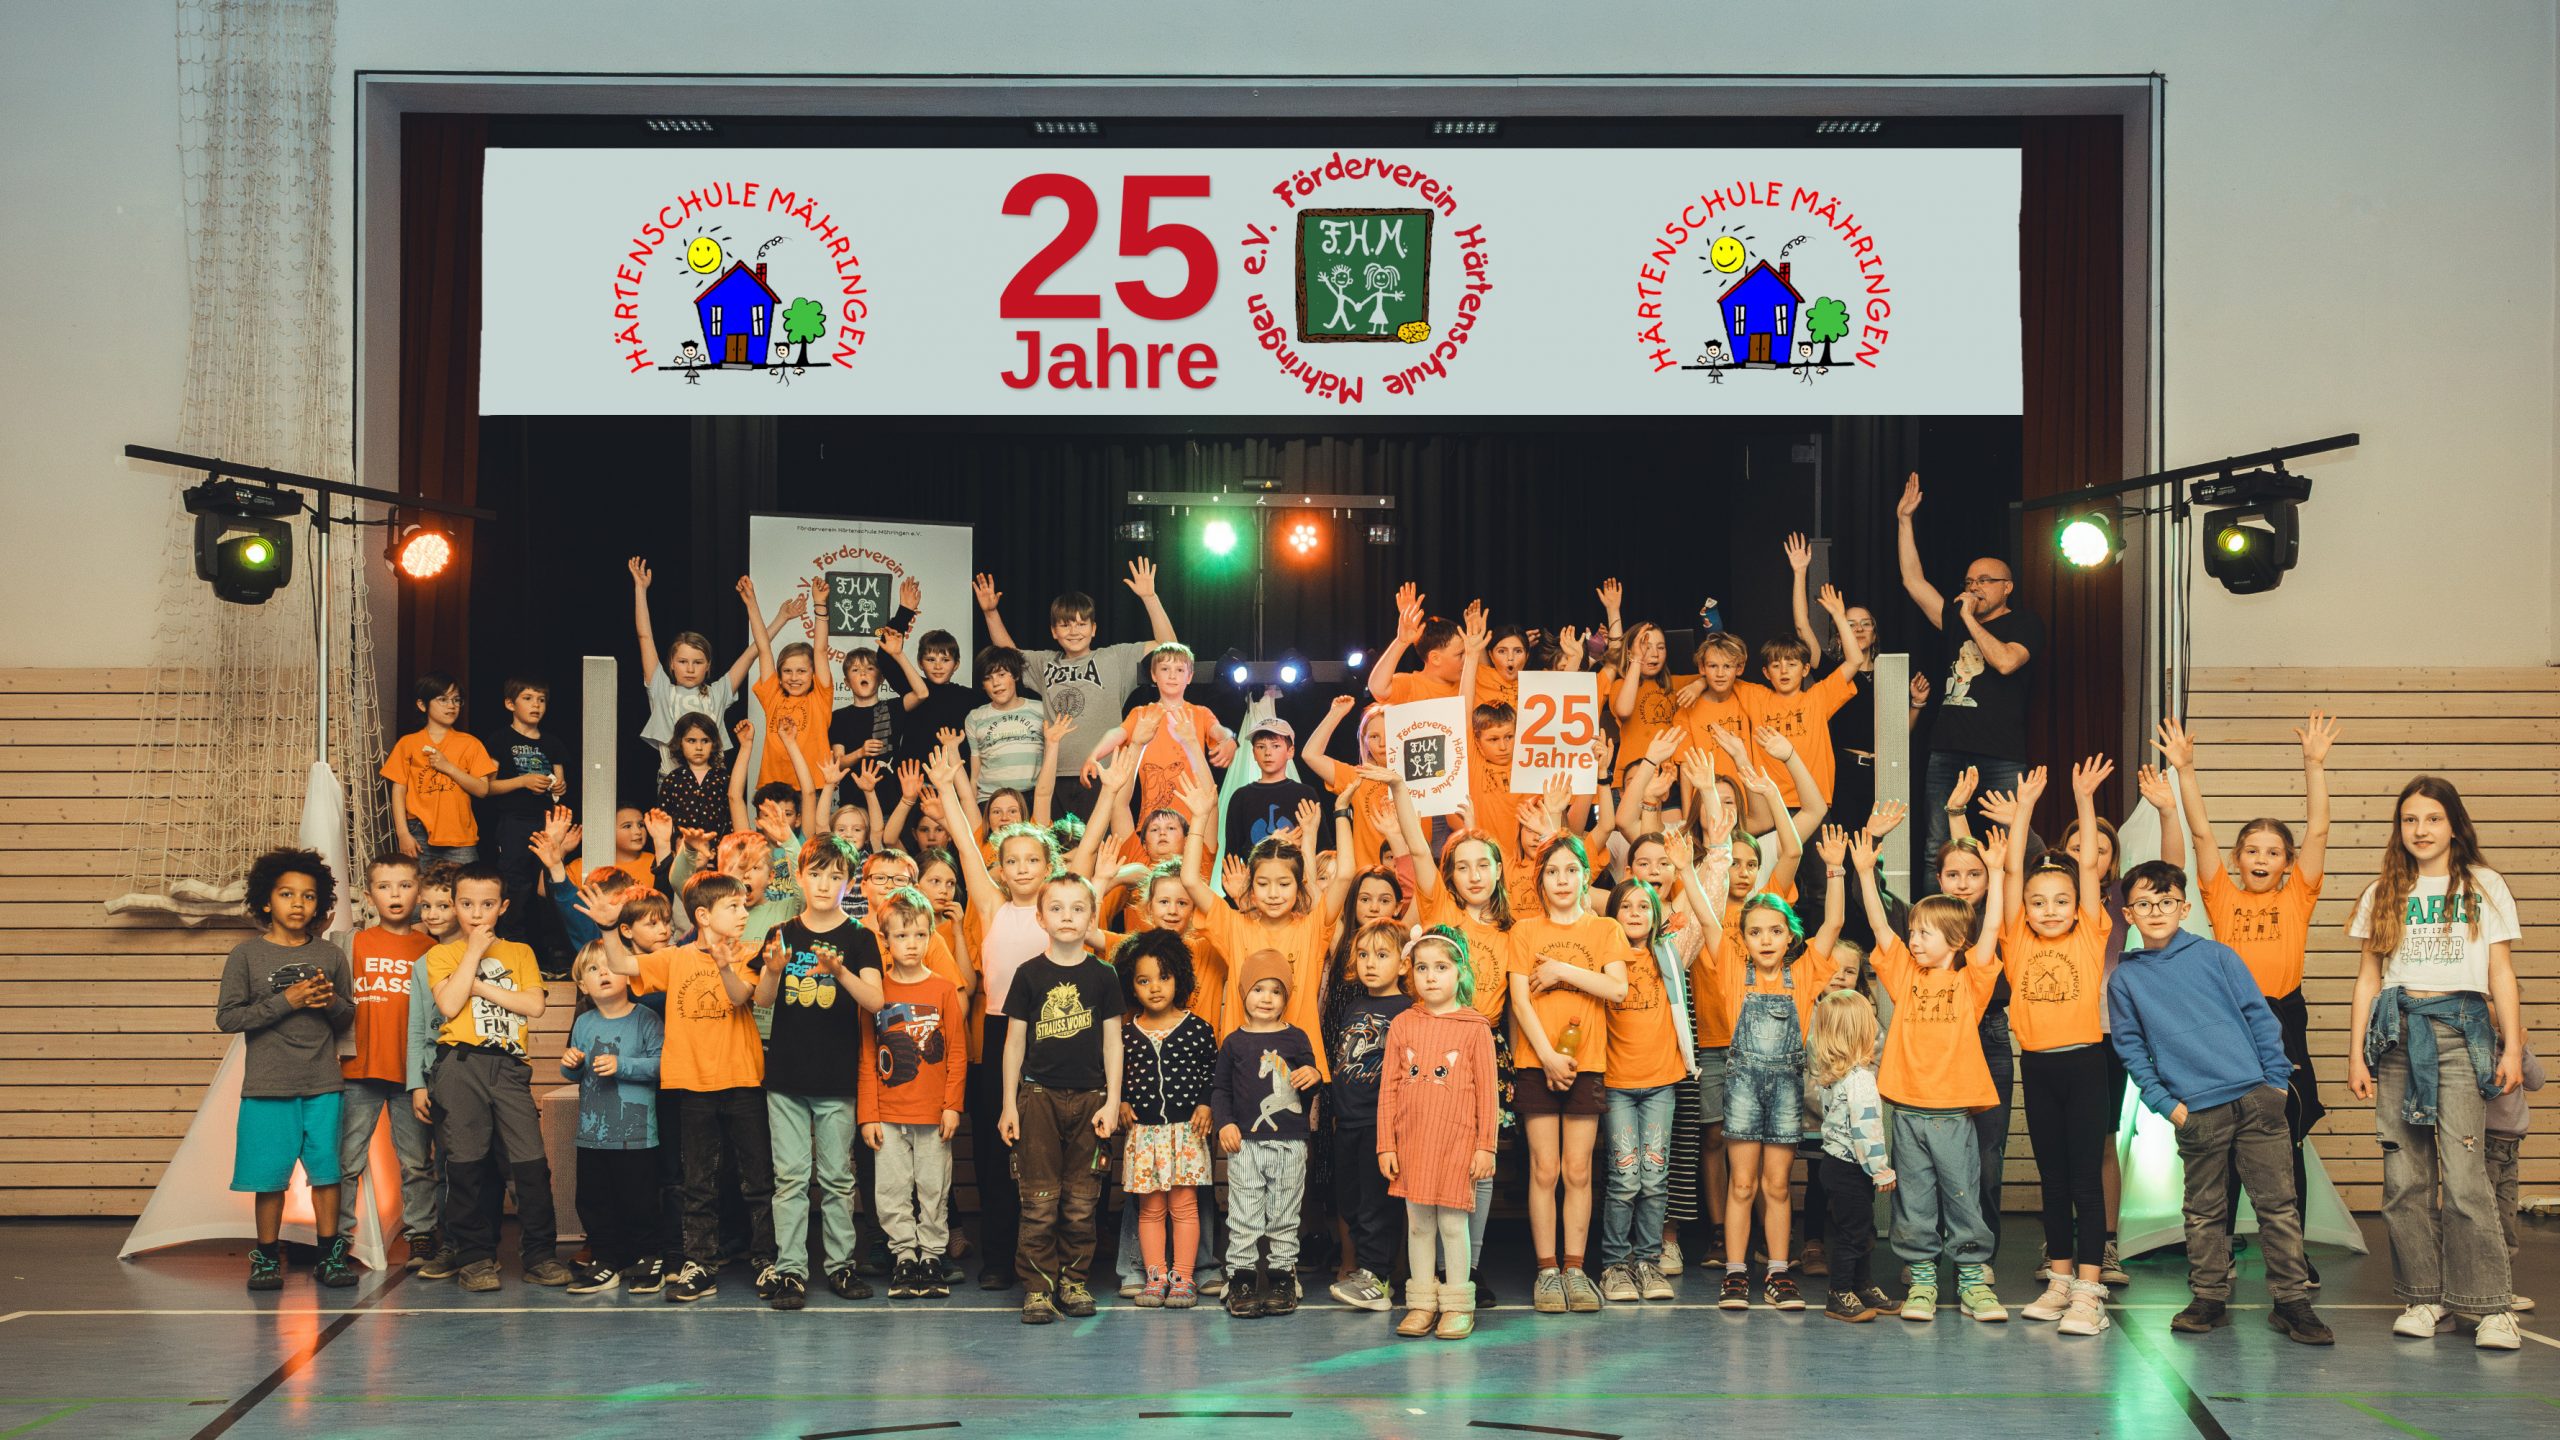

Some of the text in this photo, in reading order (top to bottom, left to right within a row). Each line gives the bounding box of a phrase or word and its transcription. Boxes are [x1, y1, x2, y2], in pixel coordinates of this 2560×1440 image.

[614, 181, 867, 373] HÄRTENSCHULE MÄHRINGEN
[999, 173, 1219, 320] 25
[1241, 152, 1494, 404] Förderverein Härtenschule Mähringen e.V.
[1637, 181, 1890, 372] HÄRTENSCHULE MÄHRINGEN
[999, 327, 1219, 390] Jahre
[813, 544, 904, 578] Förderverein
[1520, 694, 1595, 746] 25
[1396, 720, 1453, 741] Förderverein
[1431, 738, 1466, 794] Härtenschule
[1518, 747, 1593, 770] Jahre
[483, 1018, 510, 1036] FUN
